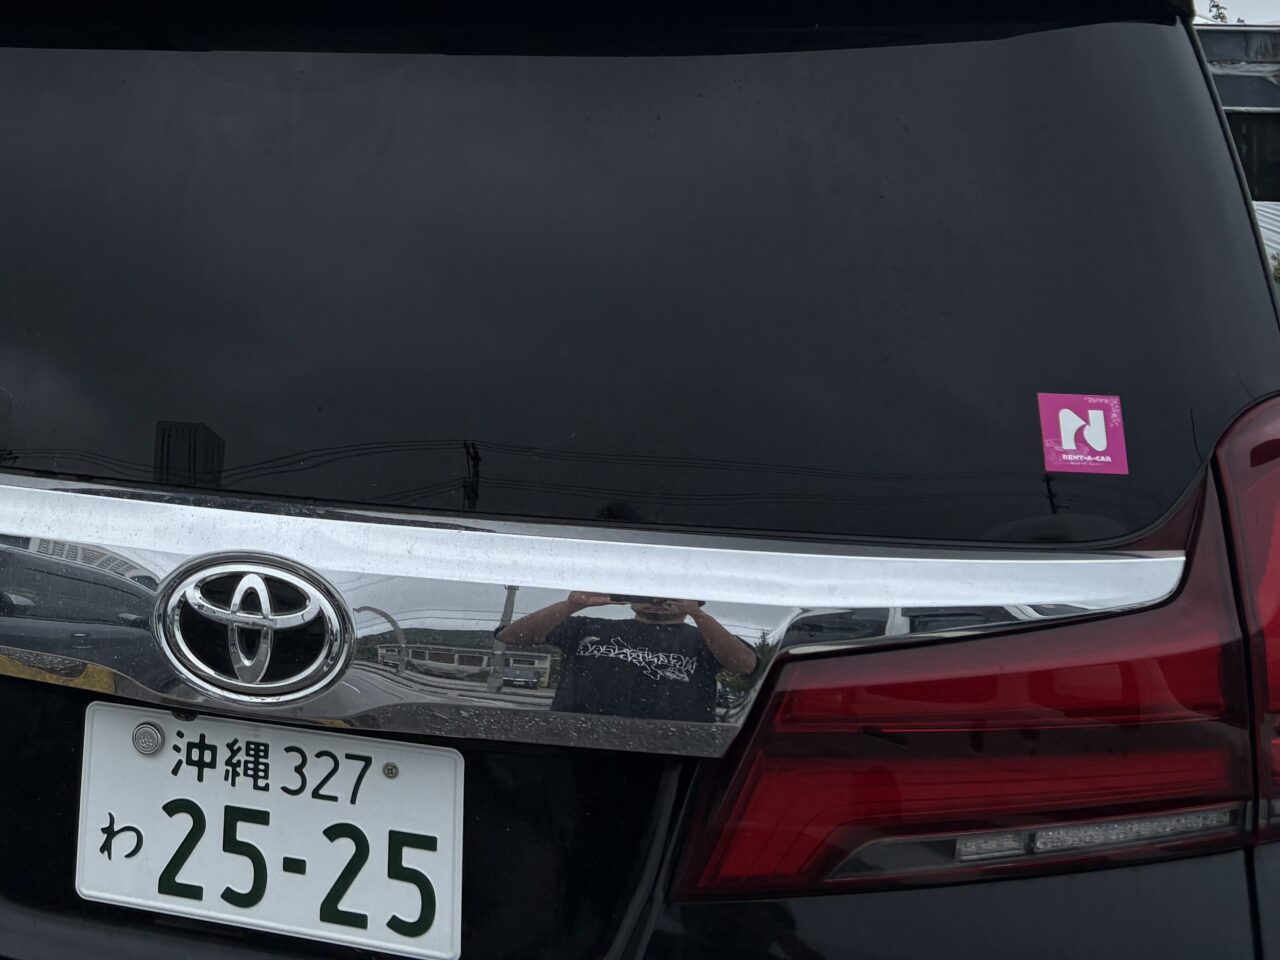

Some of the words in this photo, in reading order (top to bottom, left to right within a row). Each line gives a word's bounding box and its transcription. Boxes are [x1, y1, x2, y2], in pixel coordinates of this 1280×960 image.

[170, 729, 270, 792] 沖縄
[280, 745, 372, 805] 327
[99, 811, 144, 861] わ
[158, 798, 438, 938] 25-25
